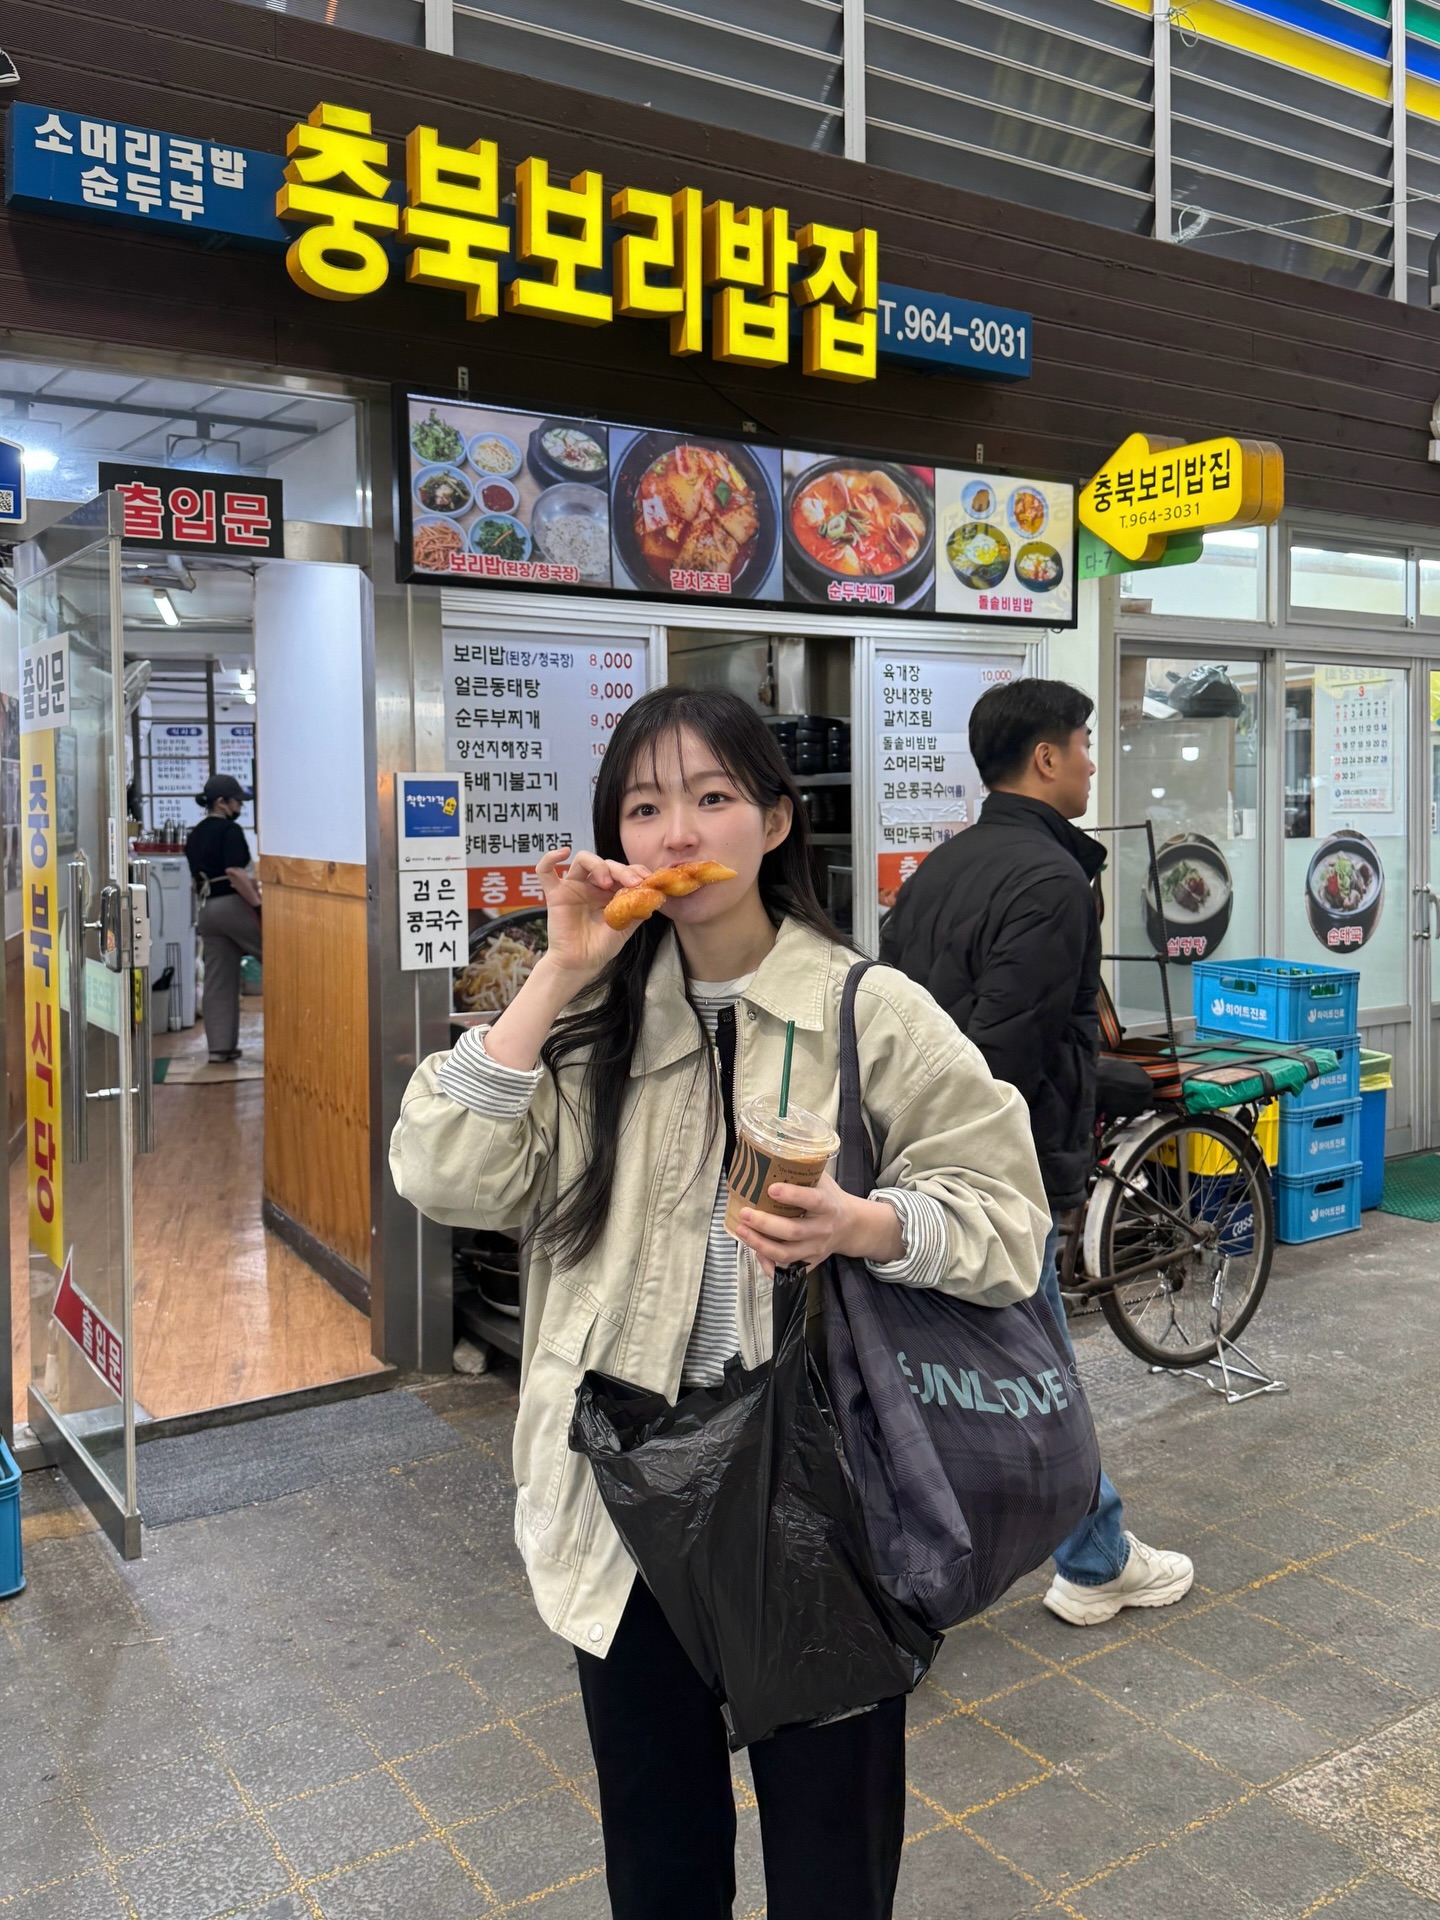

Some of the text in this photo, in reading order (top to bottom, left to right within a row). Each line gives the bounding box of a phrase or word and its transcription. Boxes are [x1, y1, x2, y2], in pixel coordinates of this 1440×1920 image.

[34, 113, 247, 190] 소머리국밥
[80, 166, 205, 221] 순두부
[275, 101, 879, 384] 충북보리밥집
[878, 299, 1026, 360] T.964-3031
[1093, 448, 1230, 513] 충북보리밥집
[115, 482, 272, 548] 출입문
[1119, 502, 1200, 529] T.964-3031
[1085, 551, 1113, 571] 다-7
[669, 569, 731, 593] 갈치조림
[979, 594, 1033, 612] 돌솥비빔밥
[453, 645, 633, 669] 보리밥(된장/청국장) 8,000
[883, 664, 1012, 682] 육개장 10,000
[23, 650, 65, 720] 출입문
[454, 676, 633, 699] 얼큰동태탕 9,000
[883, 687, 933, 705] 양내장탕
[454, 708, 623, 730] 순두부찌개 9,00
[883, 710, 932, 727] 갈치조림
[457, 740, 543, 760] 양선지해장국
[883, 736, 937, 750] 돌솥비빔밥
[883, 755, 945, 772] 소머리국밥
[406, 794, 444, 808] 착한가격
[407, 909, 463, 933] 콩국수
[1166, 936, 1207, 957] 설렁탕
[1327, 927, 1364, 946] 순대국
[1225, 1002, 1268, 1021] 하이트진로
[1317, 1008, 1345, 1020] 하이트진로
[1320, 1073, 1347, 1086] 하이트진로
[1318, 1137, 1346, 1150] 하이트진로
[1319, 1204, 1346, 1217] 하이트진로
[83, 1308, 121, 1390] 출입문
